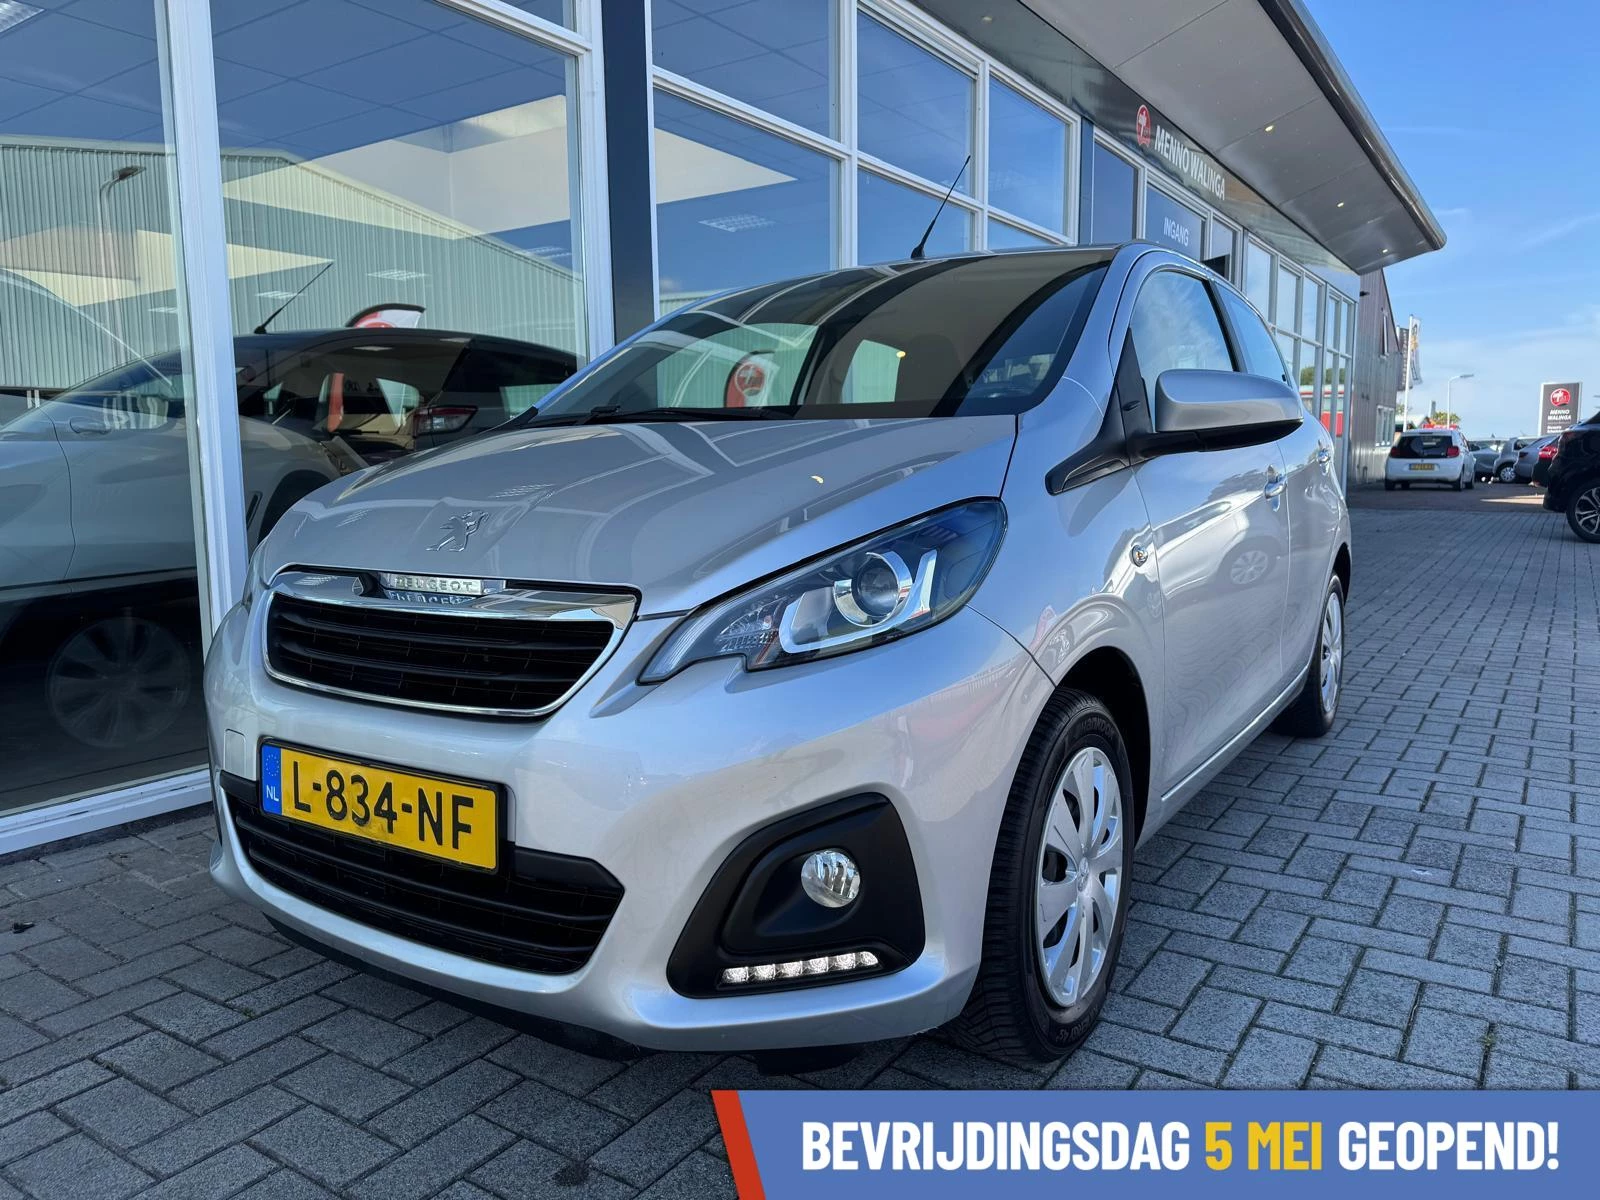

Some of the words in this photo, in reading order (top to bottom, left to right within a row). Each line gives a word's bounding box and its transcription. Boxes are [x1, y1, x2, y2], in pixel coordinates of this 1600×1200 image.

[1154, 125, 1189, 172] MENNO
[1190, 152, 1226, 200] WALINGA
[1163, 217, 1189, 247] INGANG
[395, 575, 473, 591] PEUGEOT
[266, 785, 280, 802] NL
[293, 761, 474, 850] L-834-NF
